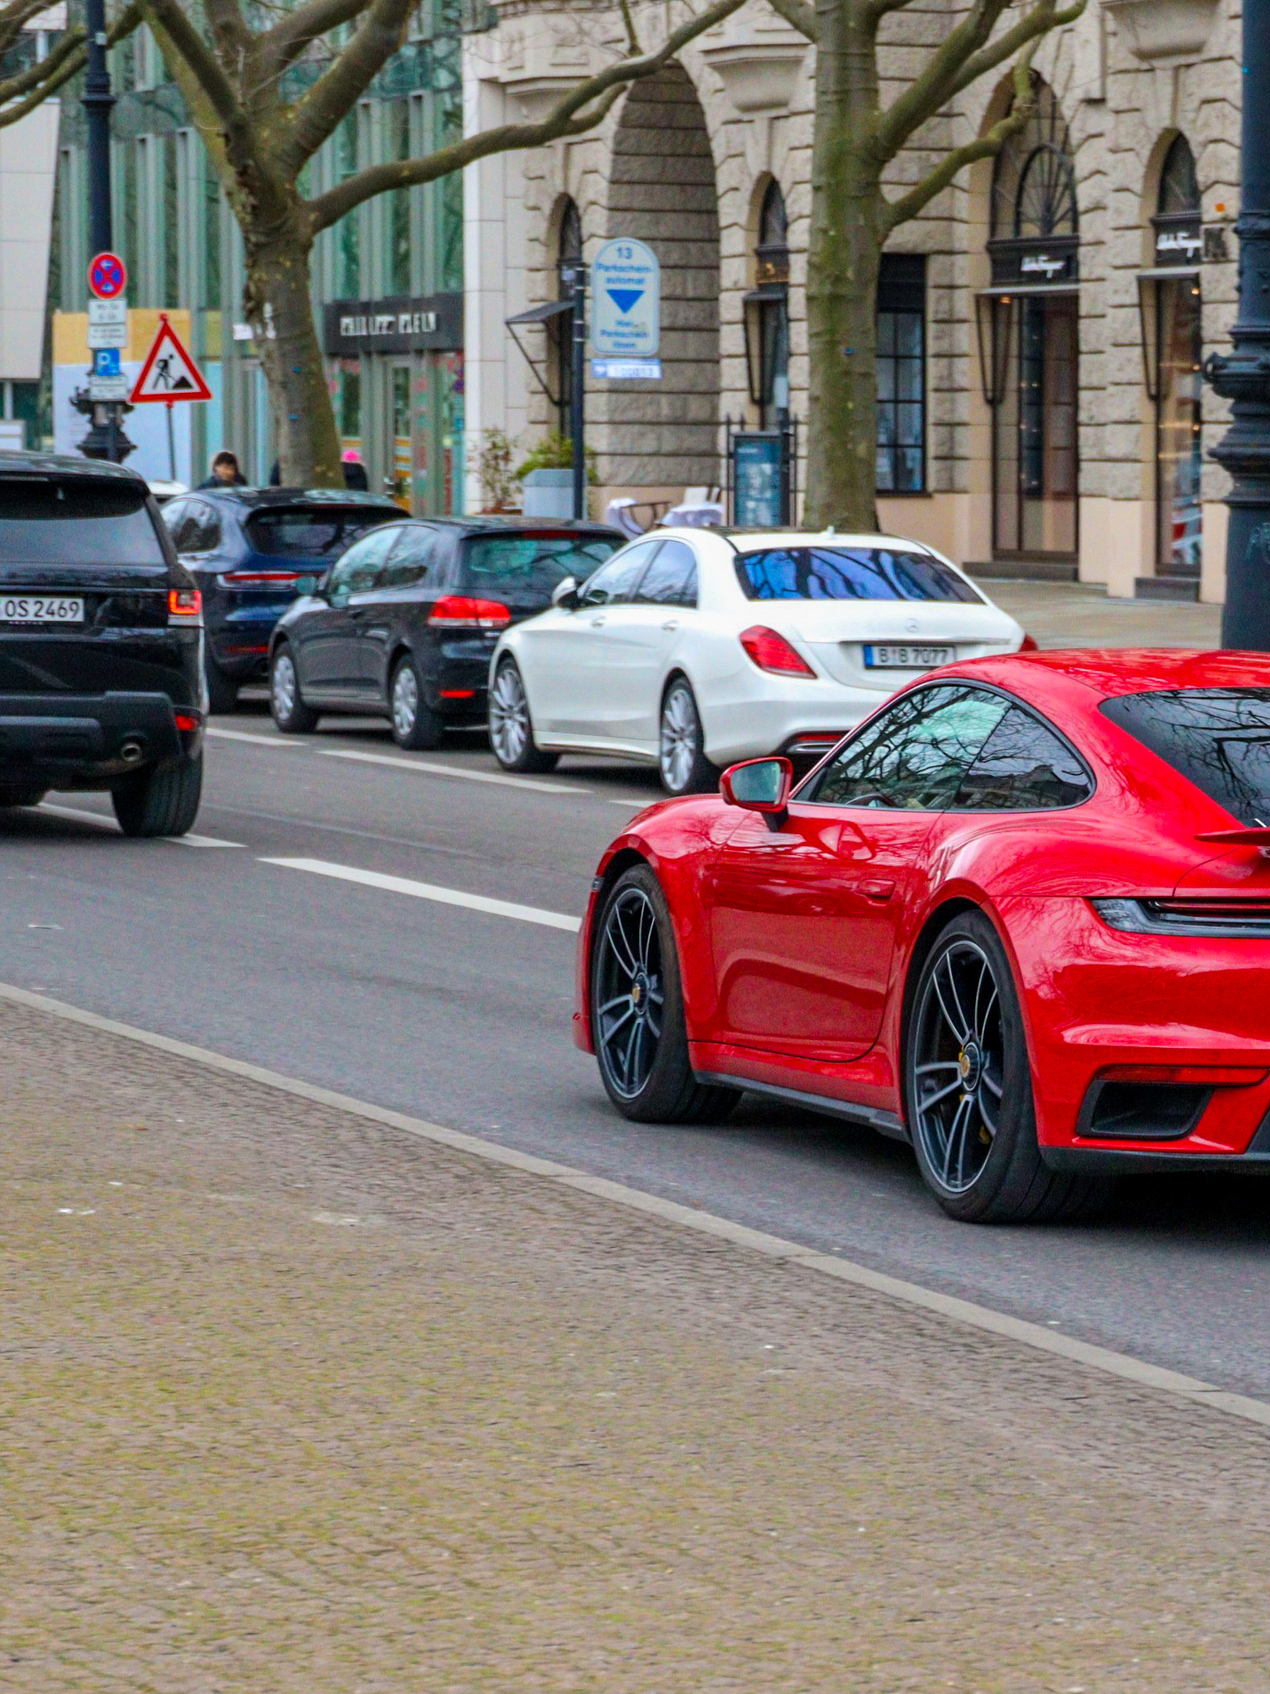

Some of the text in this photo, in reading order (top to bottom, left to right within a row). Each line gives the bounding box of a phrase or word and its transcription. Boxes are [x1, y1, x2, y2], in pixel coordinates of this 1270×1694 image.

[617, 247, 633, 259] 13
[5, 600, 79, 618] OS 2469
[880, 648, 889, 663] B
